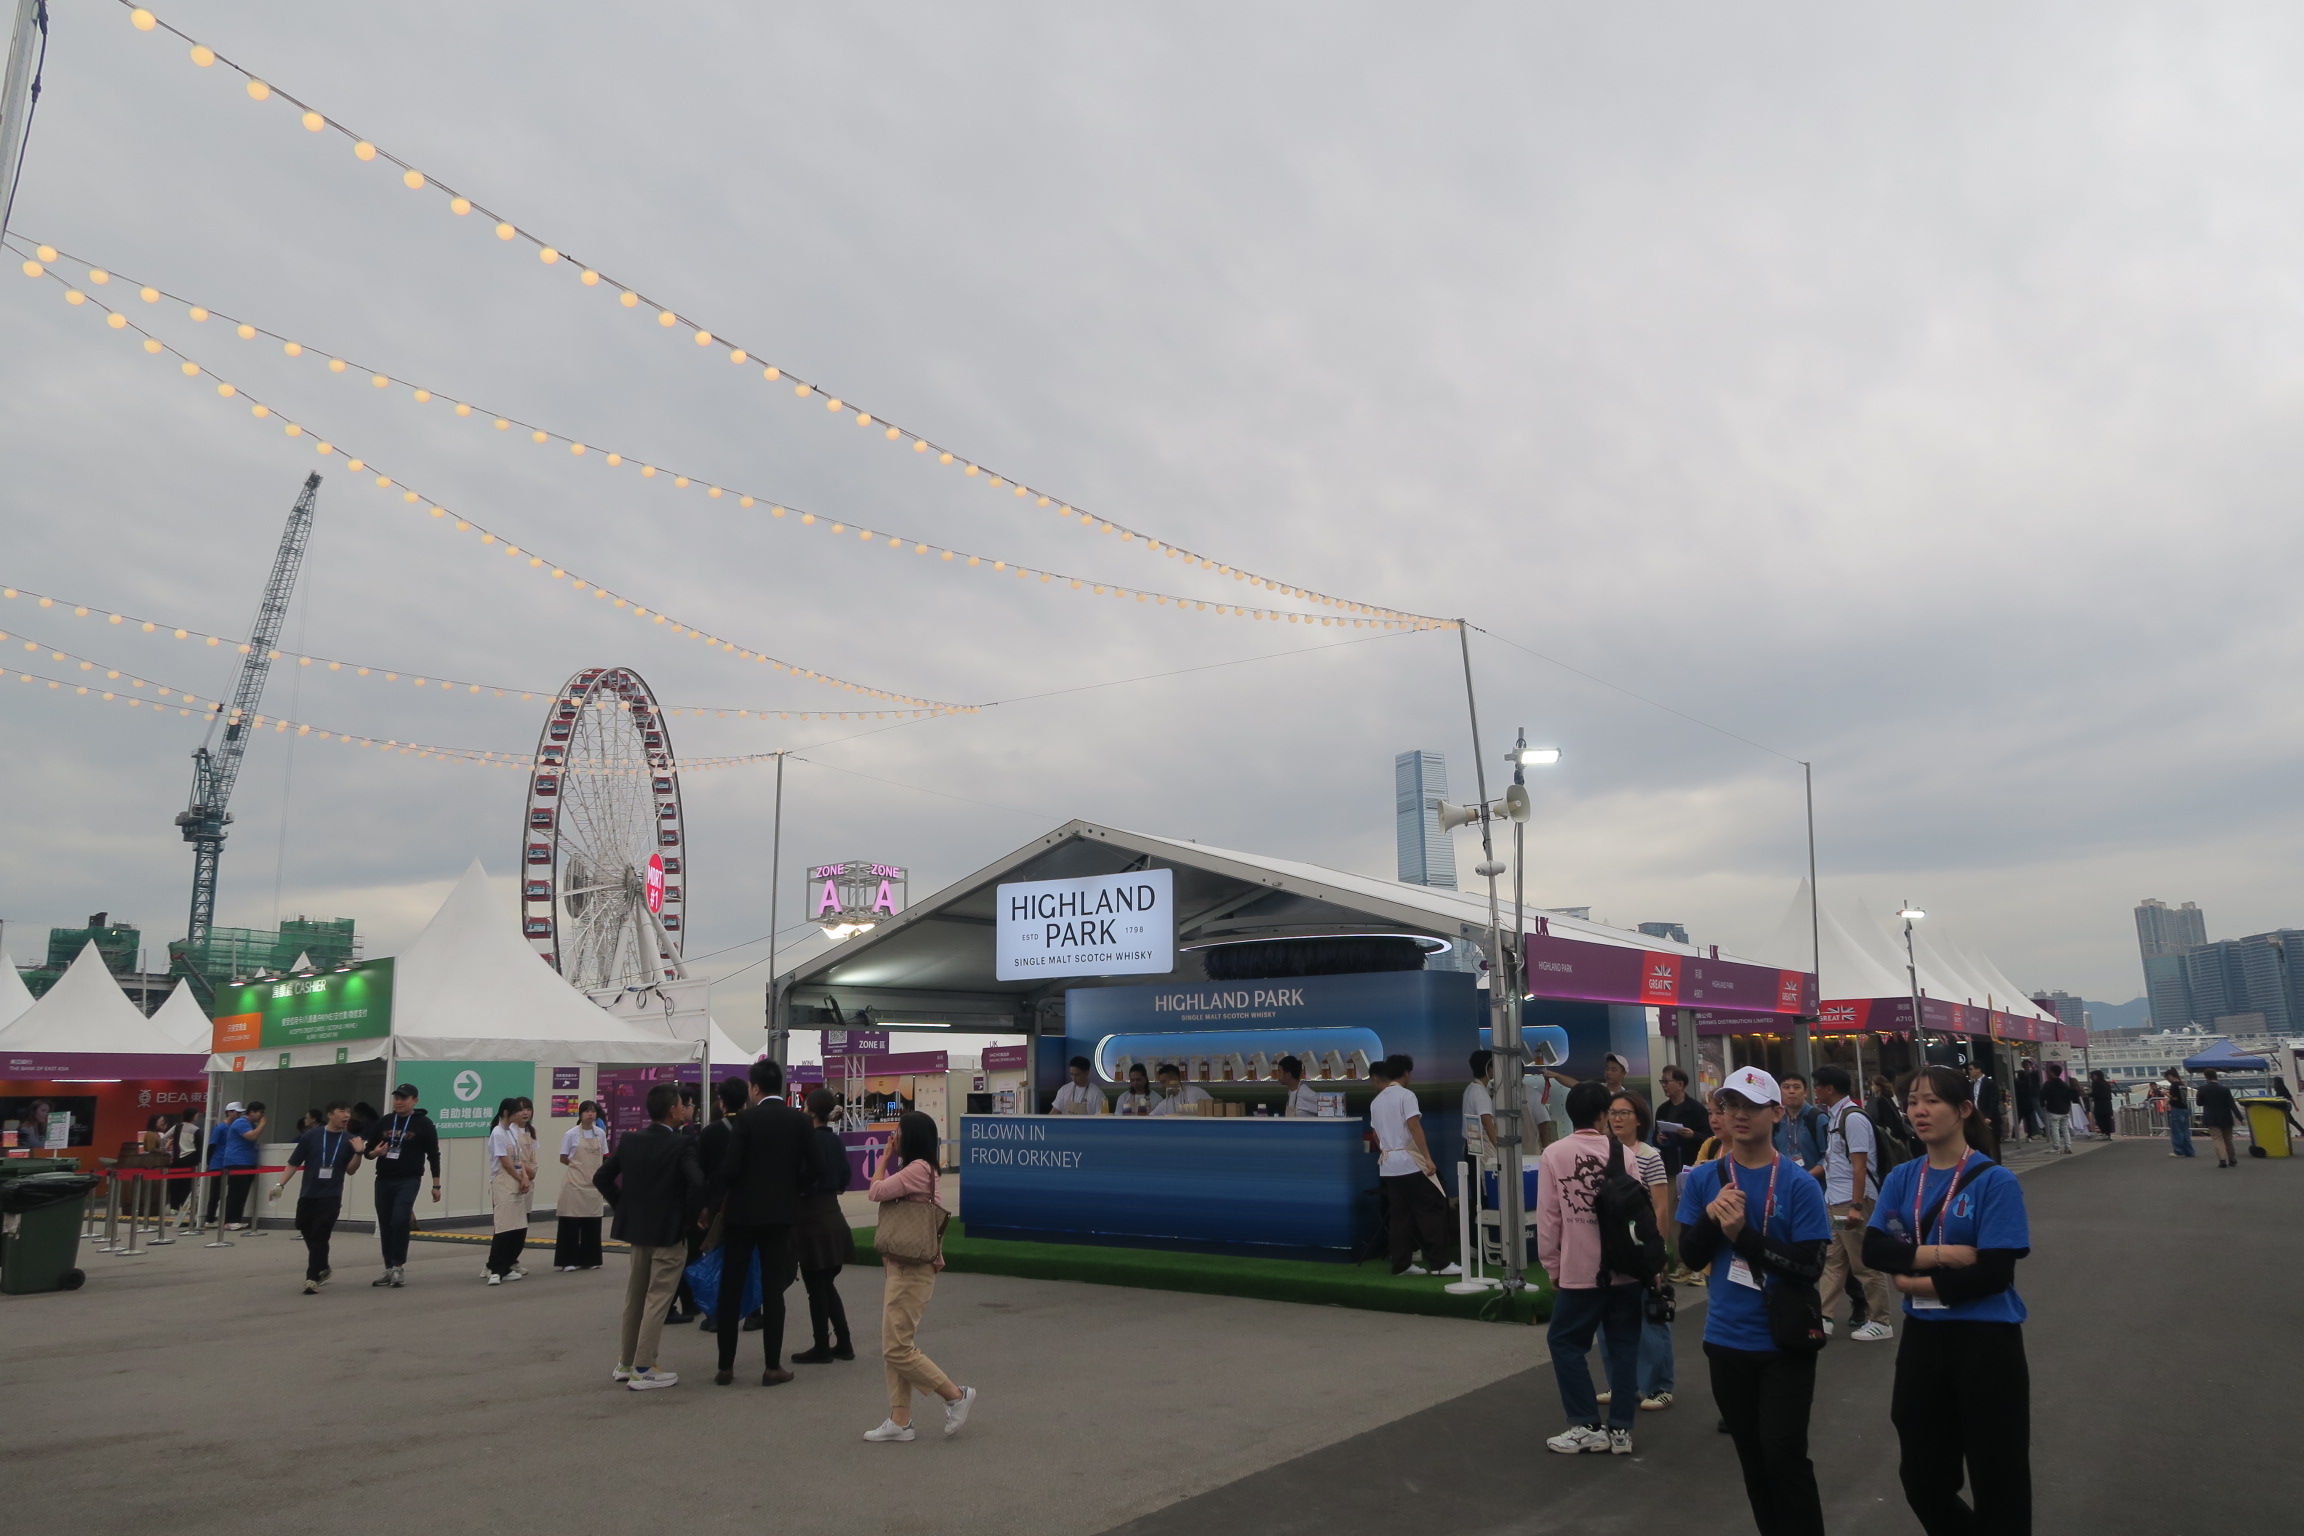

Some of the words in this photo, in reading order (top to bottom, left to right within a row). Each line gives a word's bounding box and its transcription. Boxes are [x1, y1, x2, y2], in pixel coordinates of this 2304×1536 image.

[816, 863, 845, 878] ZONE
[871, 863, 899, 878] ZONE
[650, 888, 659, 910] #1
[818, 879, 843, 915] A
[872, 879, 897, 915] A
[1011, 885, 1156, 921] HIGHLAND
[1022, 933, 1039, 941] ESTD
[1046, 918, 1117, 948] PARK
[1125, 926, 1144, 934] 1798
[1535, 915, 1550, 936] UK
[1014, 957, 1046, 967] SINGLE
[1048, 954, 1071, 965] MALT
[1074, 952, 1112, 963] SCOTCH
[1116, 950, 1153, 961] WHISKY
[1538, 961, 1561, 973] HIGHLAND
[1561, 963, 1573, 974] PARK
[294, 979, 327, 995] CASHIER
[1648, 979, 1663, 990] GREAT
[1155, 990, 1249, 1012] HIGHLAND
[1254, 988, 1305, 1008] PARK
[858, 1040, 878, 1049] ZONE
[156, 1092, 189, 1103] BEA
[440, 1107, 493, 1119] 自助增值機
[971, 1123, 1025, 1140] BLOWN
[1030, 1124, 1045, 1141] IN
[971, 1147, 1013, 1165] FROM
[1017, 1149, 1083, 1168] ORKNEY
